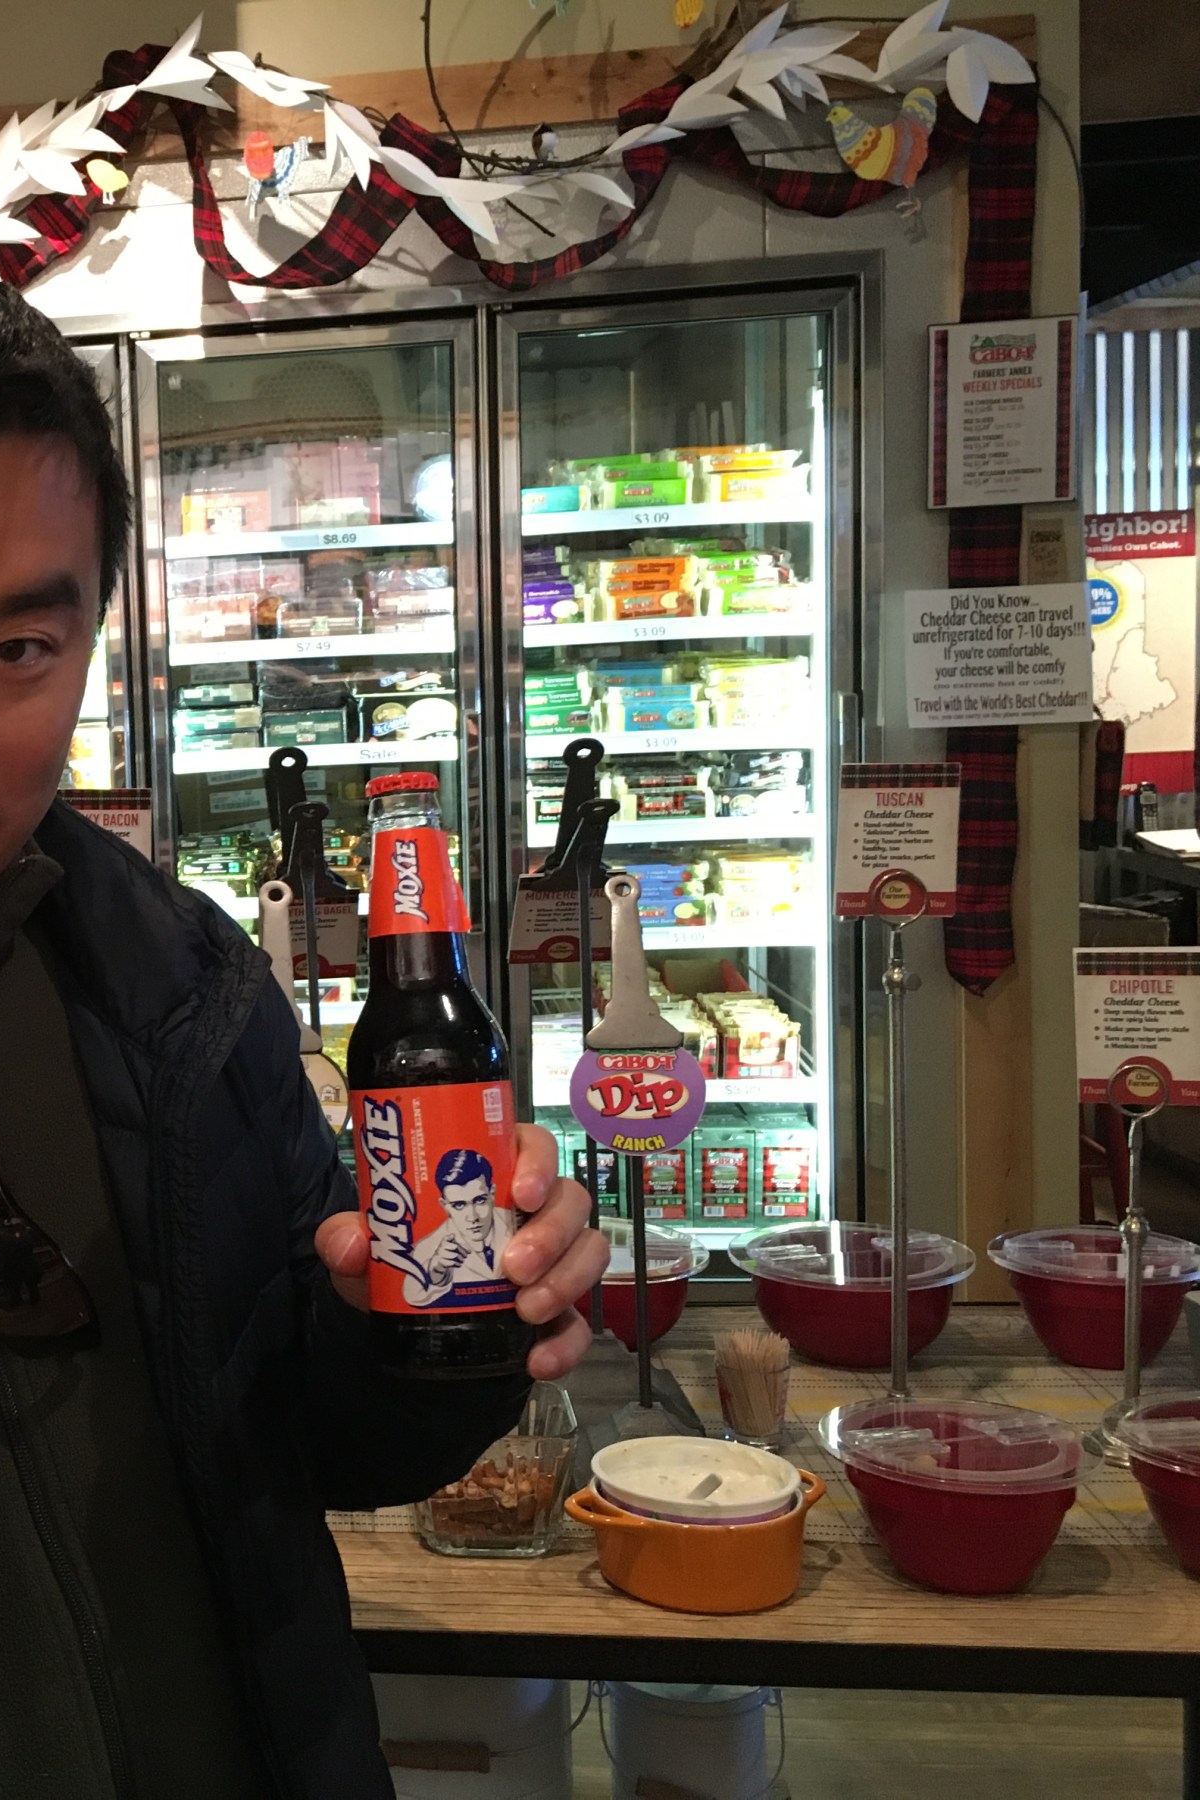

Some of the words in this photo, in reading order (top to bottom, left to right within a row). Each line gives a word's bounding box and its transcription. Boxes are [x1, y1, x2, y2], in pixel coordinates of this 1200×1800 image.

[963, 380, 998, 393] WEEKLY
[1000, 376, 1042, 391] SPECIALS
[635, 512, 669, 525] $3.09
[323, 533, 357, 545] $8.69
[1125, 543, 1148, 551] Own
[951, 595, 969, 611] Did
[973, 596, 994, 609] You
[921, 611, 967, 627] Cheddar
[970, 610, 1011, 625] Cheese
[1015, 611, 1036, 623] can
[1039, 606, 1073, 621] travel
[913, 627, 993, 647] unrefrigerated
[997, 627, 1013, 641] for
[1018, 624, 1043, 640] 7-10
[1047, 622, 1086, 640] days!!!
[944, 648, 952, 660] If
[953, 647, 984, 662] you're
[987, 643, 1052, 659] comfortable,
[935, 667, 958, 681] your
[960, 664, 994, 677] cheese
[997, 662, 1014, 675] will
[1017, 662, 1029, 674] be
[1032, 659, 1066, 676] comfy
[914, 697, 942, 713] Travel
[943, 697, 963, 711] with
[964, 695, 978, 710] the
[979, 694, 1013, 710] World's
[1016, 693, 1036, 708] Best
[1039, 691, 1088, 707] Cheddar!!!
[360, 748, 397, 759] Sale
[876, 792, 925, 807] TUSCAN
[103, 813, 139, 826] BACON
[864, 810, 902, 819] Cheddar
[904, 810, 934, 819] Cheese
[392, 839, 429, 924] MOXIE
[1110, 980, 1175, 994] CHIPOTLE
[1104, 997, 1145, 1006] Cheddar
[1148, 997, 1180, 1006] Cheese
[598, 1054, 677, 1070] CABOT
[590, 1072, 684, 1119] Dip
[1083, 1087, 1106, 1095] Than
[612, 1134, 666, 1151] RANCH
[361, 1095, 432, 1292] MOXIE
